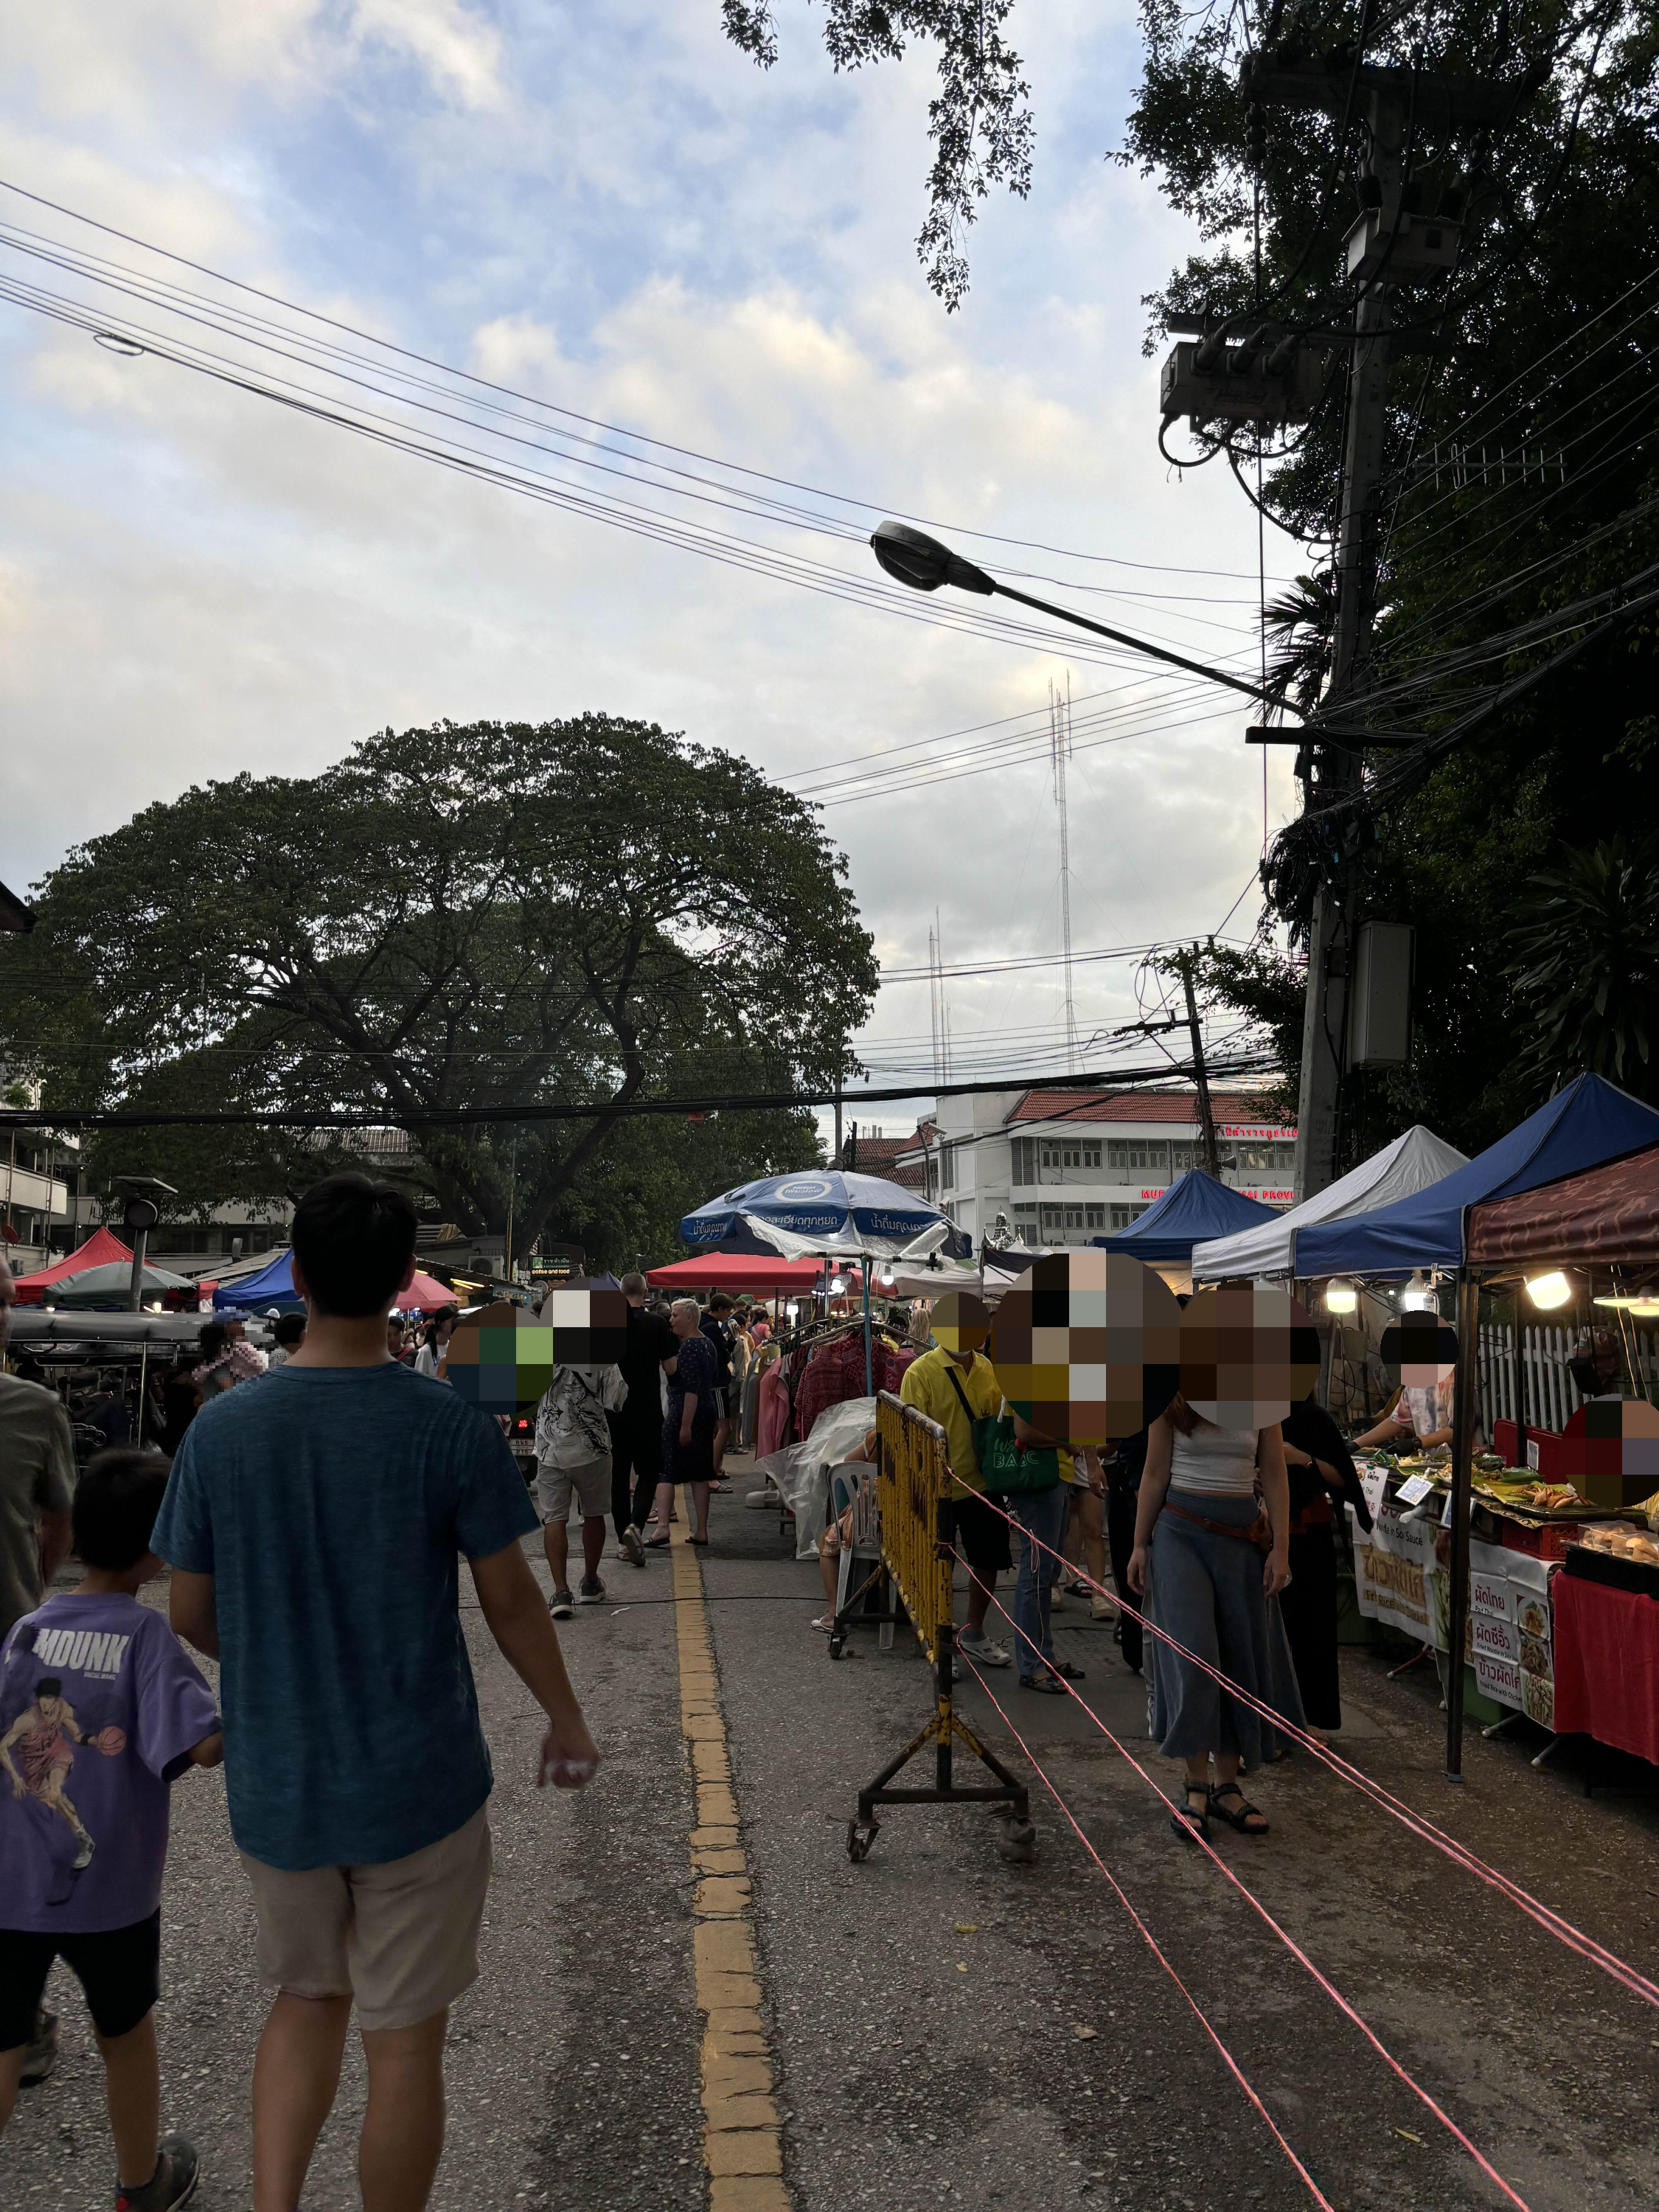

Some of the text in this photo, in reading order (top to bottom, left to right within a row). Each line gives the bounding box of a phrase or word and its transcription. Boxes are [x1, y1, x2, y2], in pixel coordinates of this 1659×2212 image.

[993, 1450, 1040, 1468] BAAC
[1405, 1531, 1423, 1546] Sauce
[1475, 1585, 1505, 1610] ผัดไทย
